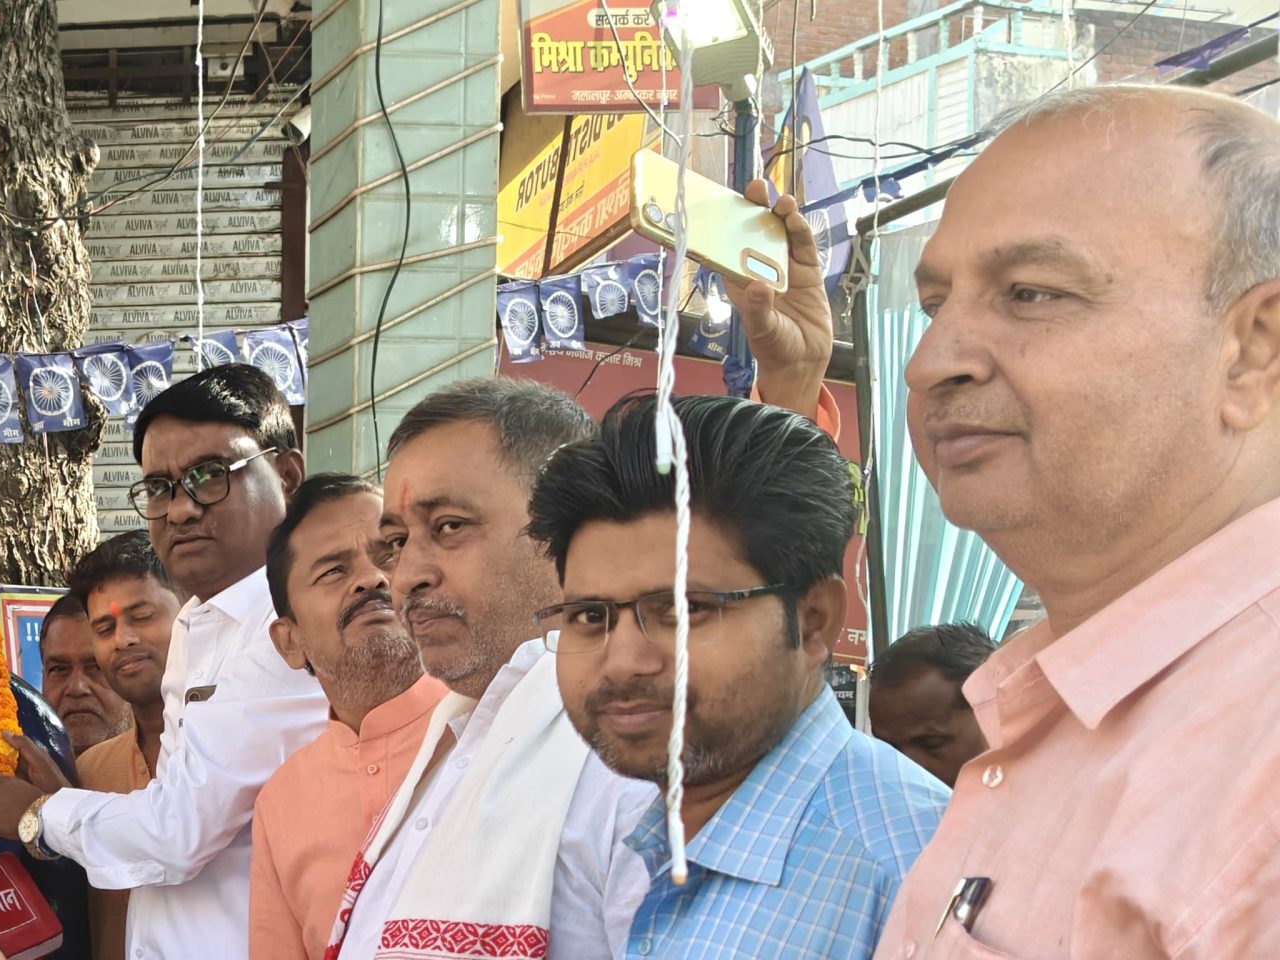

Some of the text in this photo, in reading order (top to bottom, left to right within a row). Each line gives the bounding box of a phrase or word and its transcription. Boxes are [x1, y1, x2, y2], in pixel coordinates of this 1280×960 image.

[531, 32, 584, 73] मिश्रा
[131, 128, 158, 139] ALVIVA
[108, 149, 135, 162] ALVIVA
[151, 193, 178, 205] ALVIVA
[125, 219, 152, 231] ALVIVA
[130, 244, 157, 255] ALVIVA
[110, 265, 137, 277] ALVIVA
[162, 264, 189, 276] ALVIVA
[230, 282, 257, 294] ALVIVA
[623, 352, 642, 367] मिश्र
[102, 447, 129, 458] ALVIVA
[103, 472, 130, 482] ALVIVA
[114, 517, 141, 526] ALVIVA
